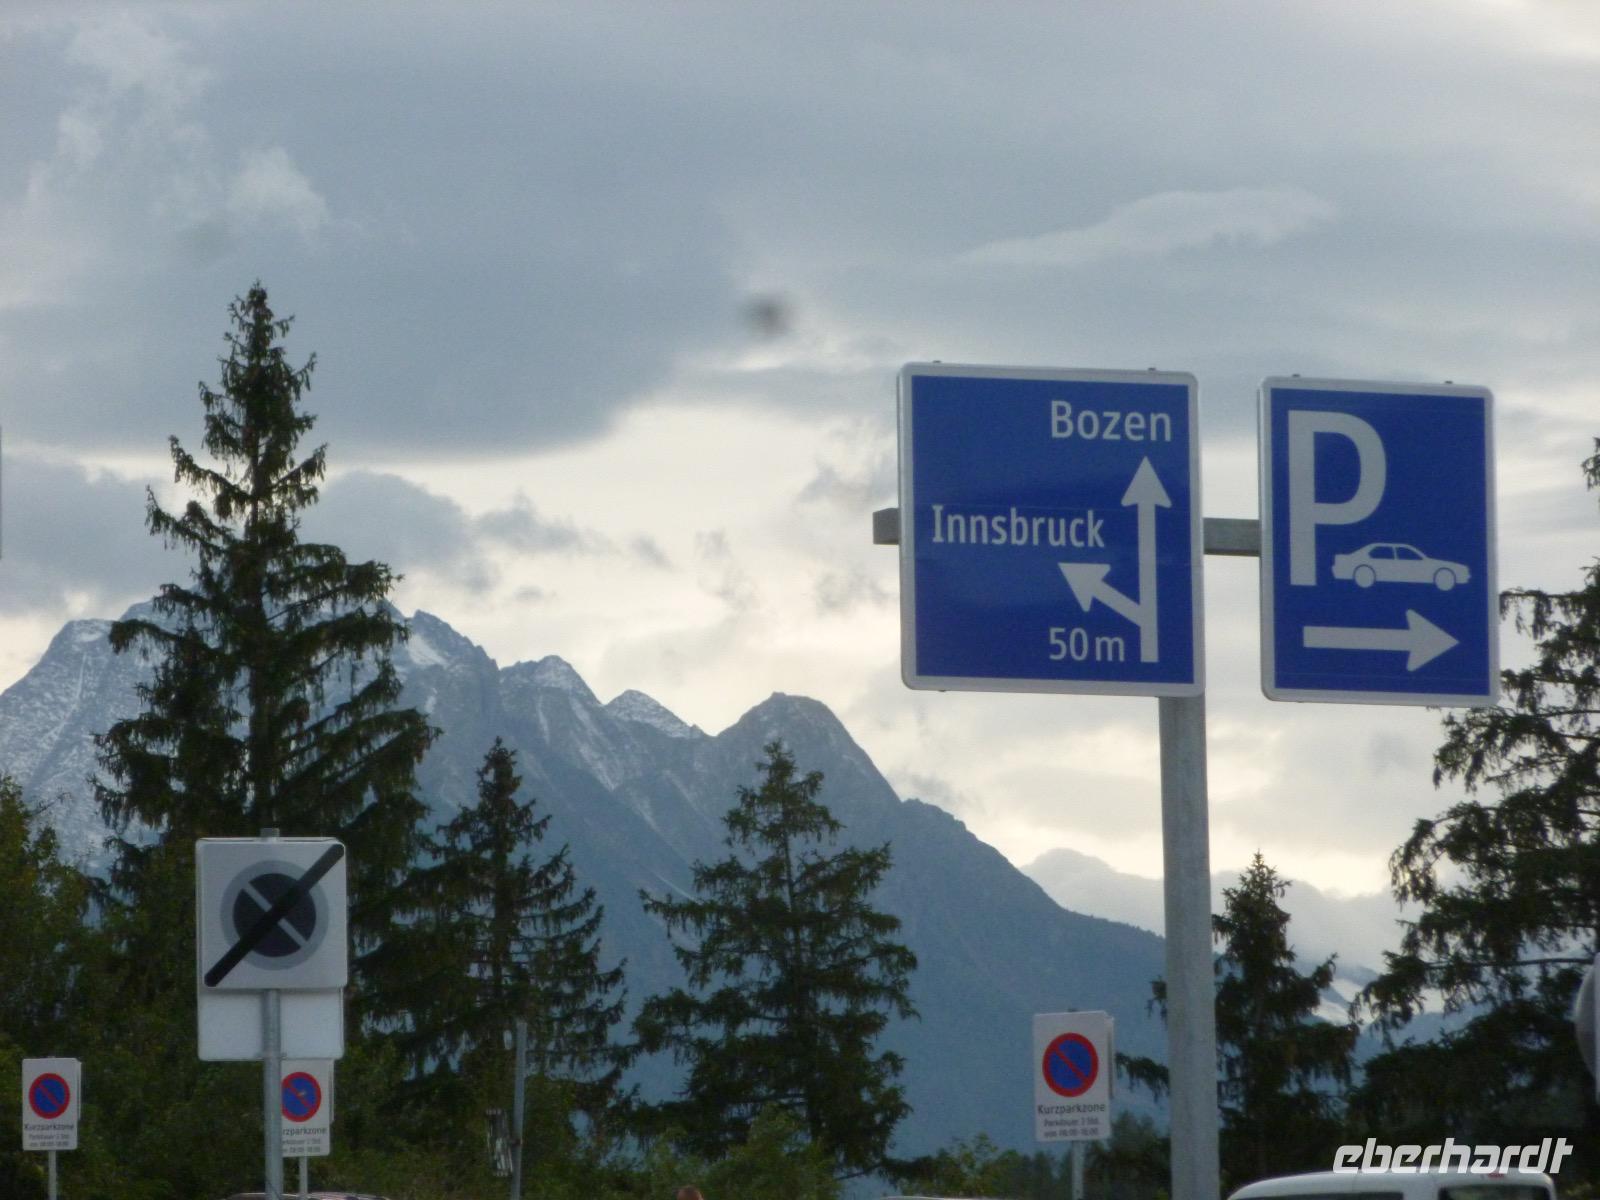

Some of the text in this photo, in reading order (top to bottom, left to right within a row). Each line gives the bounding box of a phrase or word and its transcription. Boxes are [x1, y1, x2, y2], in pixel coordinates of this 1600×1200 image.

[1050, 400, 1171, 442] Bozen
[1288, 409, 1387, 587] P
[932, 504, 1105, 548] Innsbruck
[1049, 627, 1125, 663] 50 m
[1037, 1104, 1106, 1115] Kurzparkzone
[282, 1127, 327, 1136] rzparkzone
